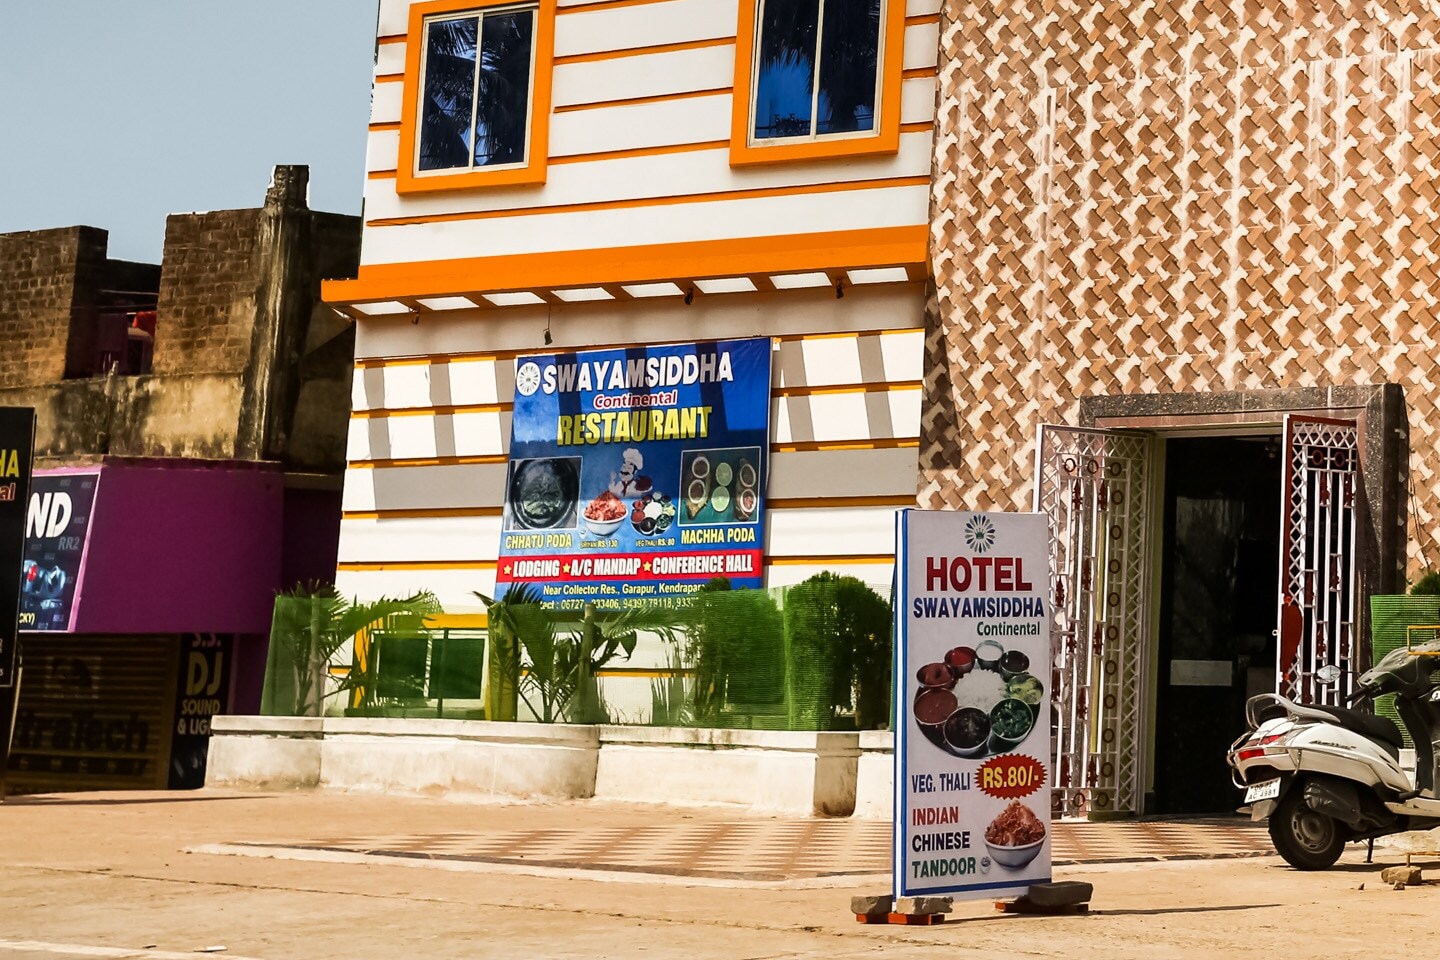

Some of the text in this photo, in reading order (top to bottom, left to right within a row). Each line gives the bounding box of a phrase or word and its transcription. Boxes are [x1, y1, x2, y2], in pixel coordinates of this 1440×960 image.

[542, 351, 734, 394] SWAYAMSIDDHA
[593, 390, 678, 409] Continental
[557, 406, 712, 446] RESTAURANT
[505, 533, 573, 549] CHHATU PODA
[681, 527, 755, 545] MACHHA PODA
[513, 559, 560, 578] LODGING
[570, 557, 641, 577] A/C MANDAP
[652, 554, 753, 575] CONFERENCE HALL
[926, 556, 1032, 592] HOTEL
[543, 585, 562, 595] Near
[563, 584, 600, 595] Collector
[622, 583, 657, 596] Garapur,
[913, 597, 1045, 618] SWAYAMSIDDHA
[976, 621, 1041, 636] Continental
[185, 651, 223, 696] DJ
[181, 699, 220, 715] SOUND
[177, 718, 212, 736] & LIG
[912, 772, 971, 793] VEG. THALI
[983, 766, 1039, 789] RS.80/-
[912, 806, 959, 826] INDIAN
[912, 831, 971, 852] CHINESE
[912, 857, 976, 879] TANDOOR
